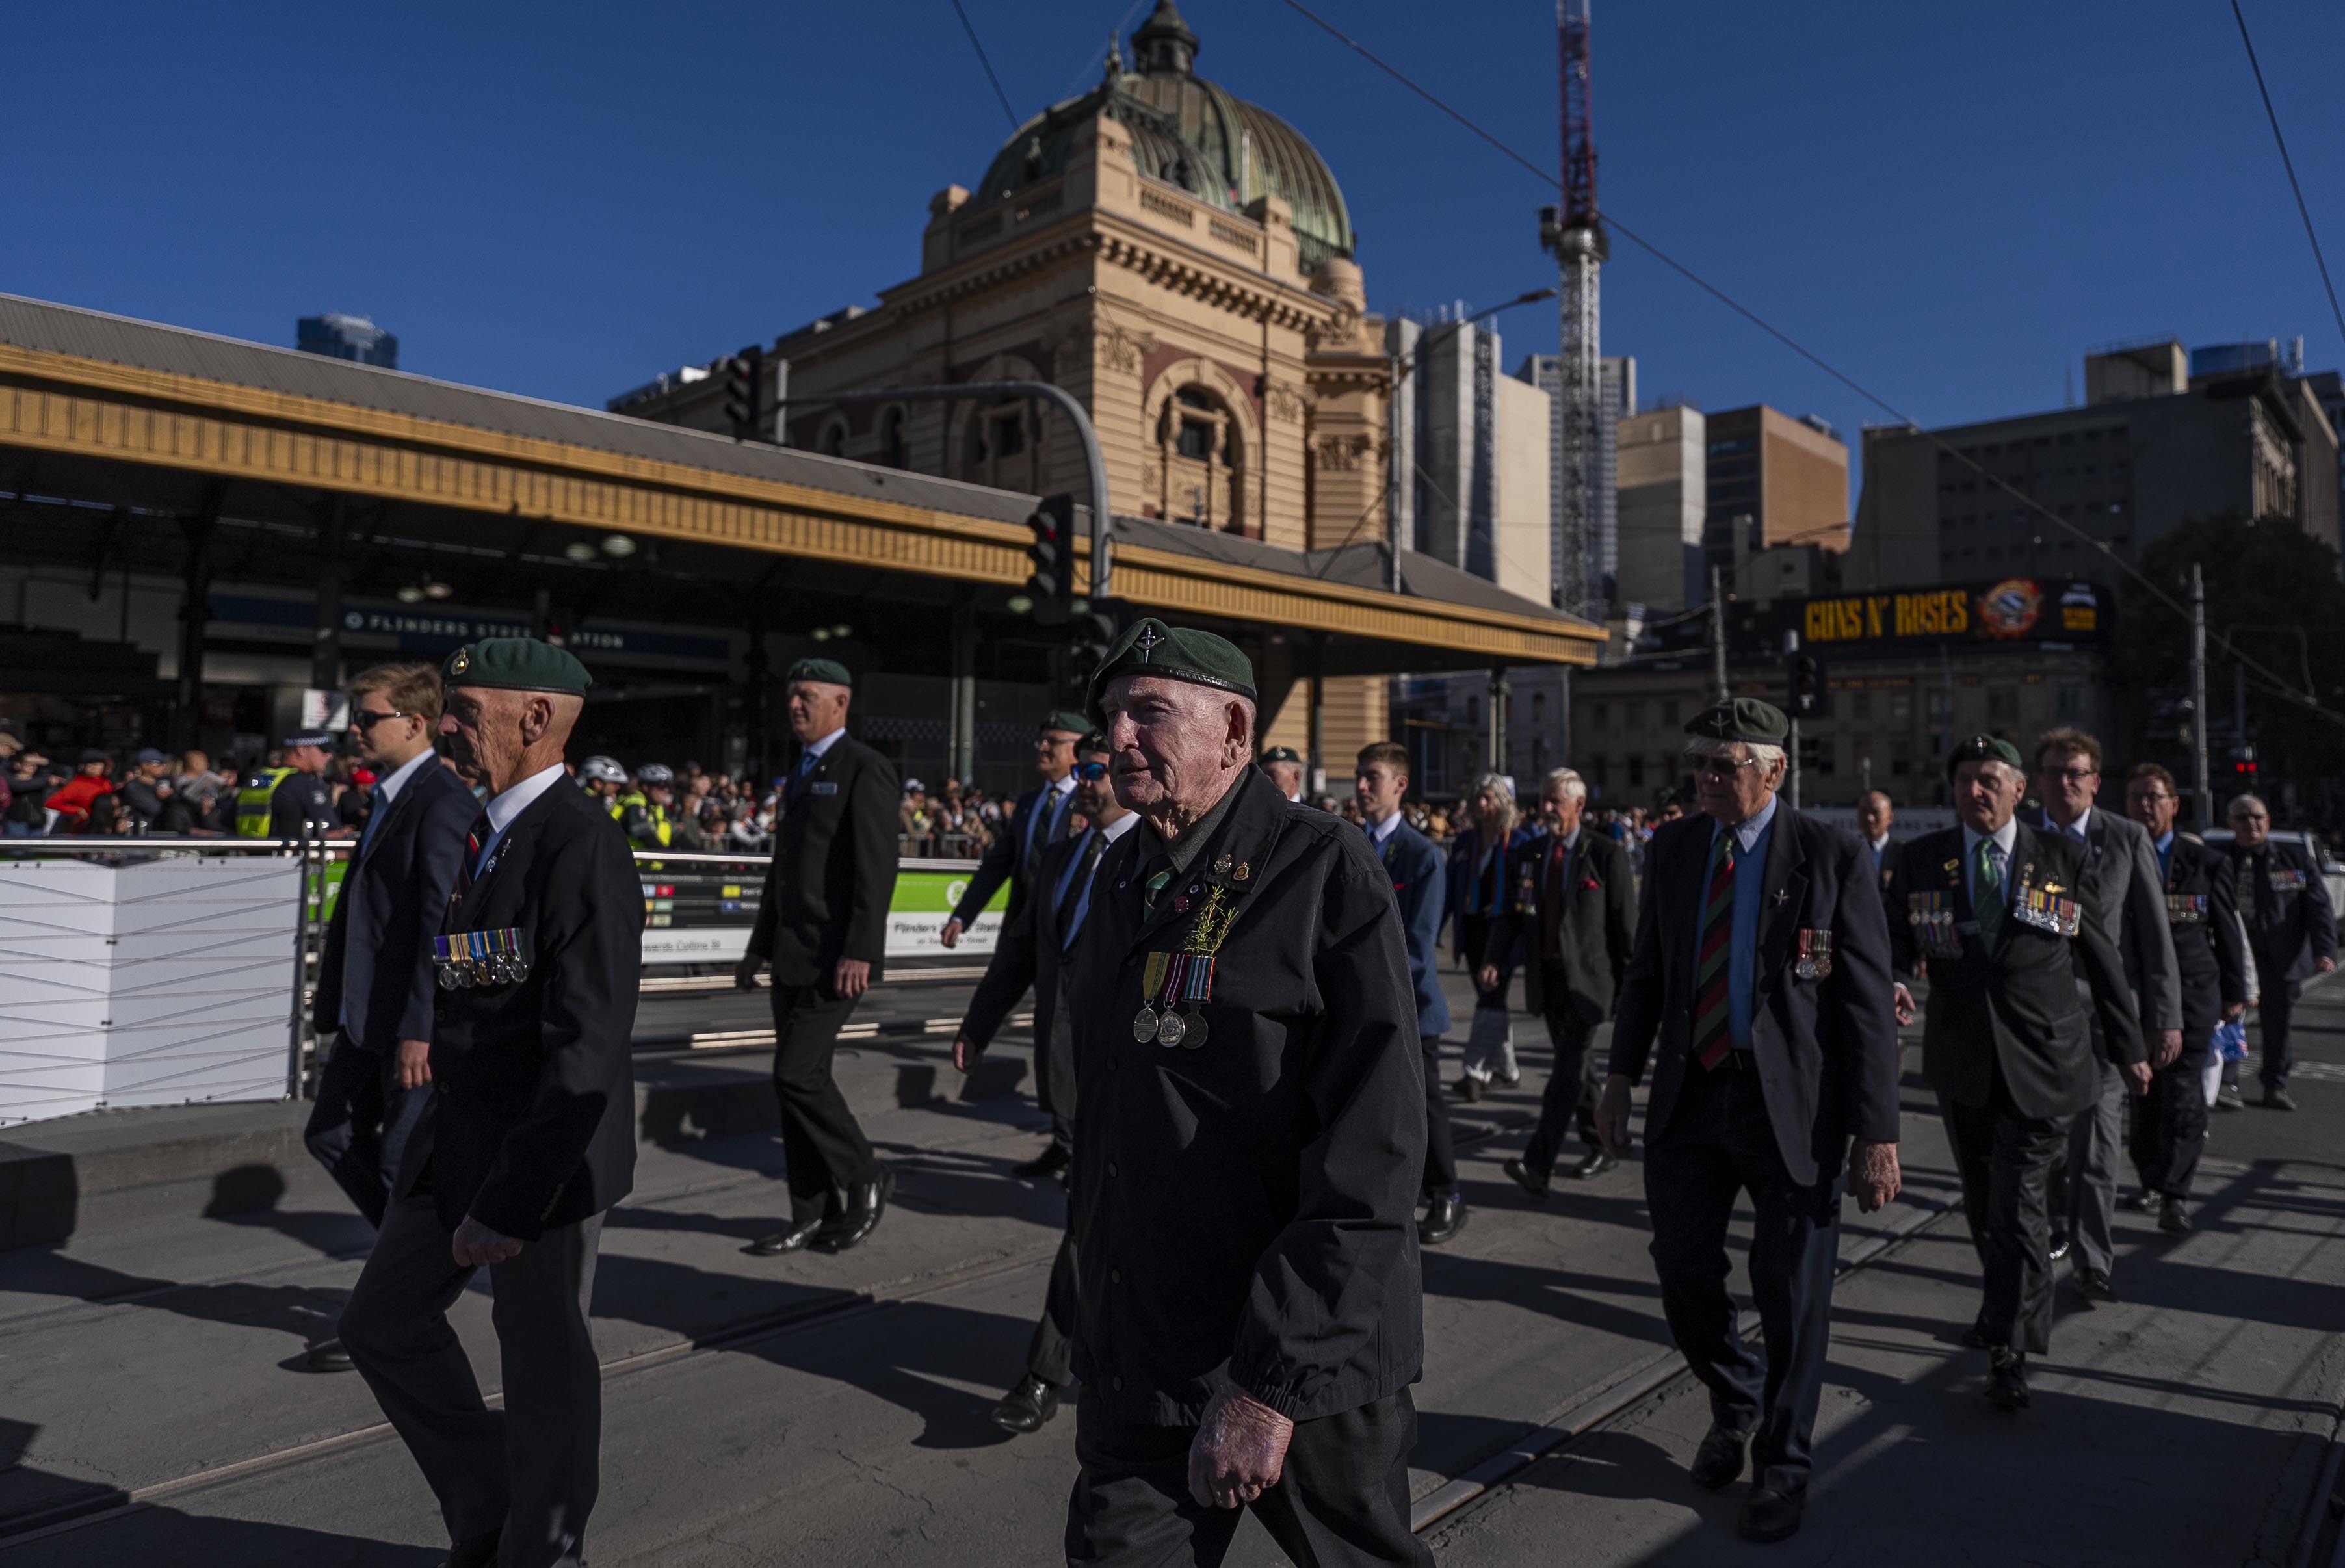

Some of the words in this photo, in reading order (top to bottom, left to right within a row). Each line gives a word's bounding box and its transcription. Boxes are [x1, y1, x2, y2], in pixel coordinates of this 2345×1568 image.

[369, 614, 469, 637] FLINDERS
[475, 623, 532, 638] STREE
[570, 631, 625, 649] ATION
[1805, 599, 1863, 642] GUNS
[1866, 595, 1891, 639] N'
[1894, 589, 1969, 637] ROSES
[895, 923, 936, 933] Flinders
